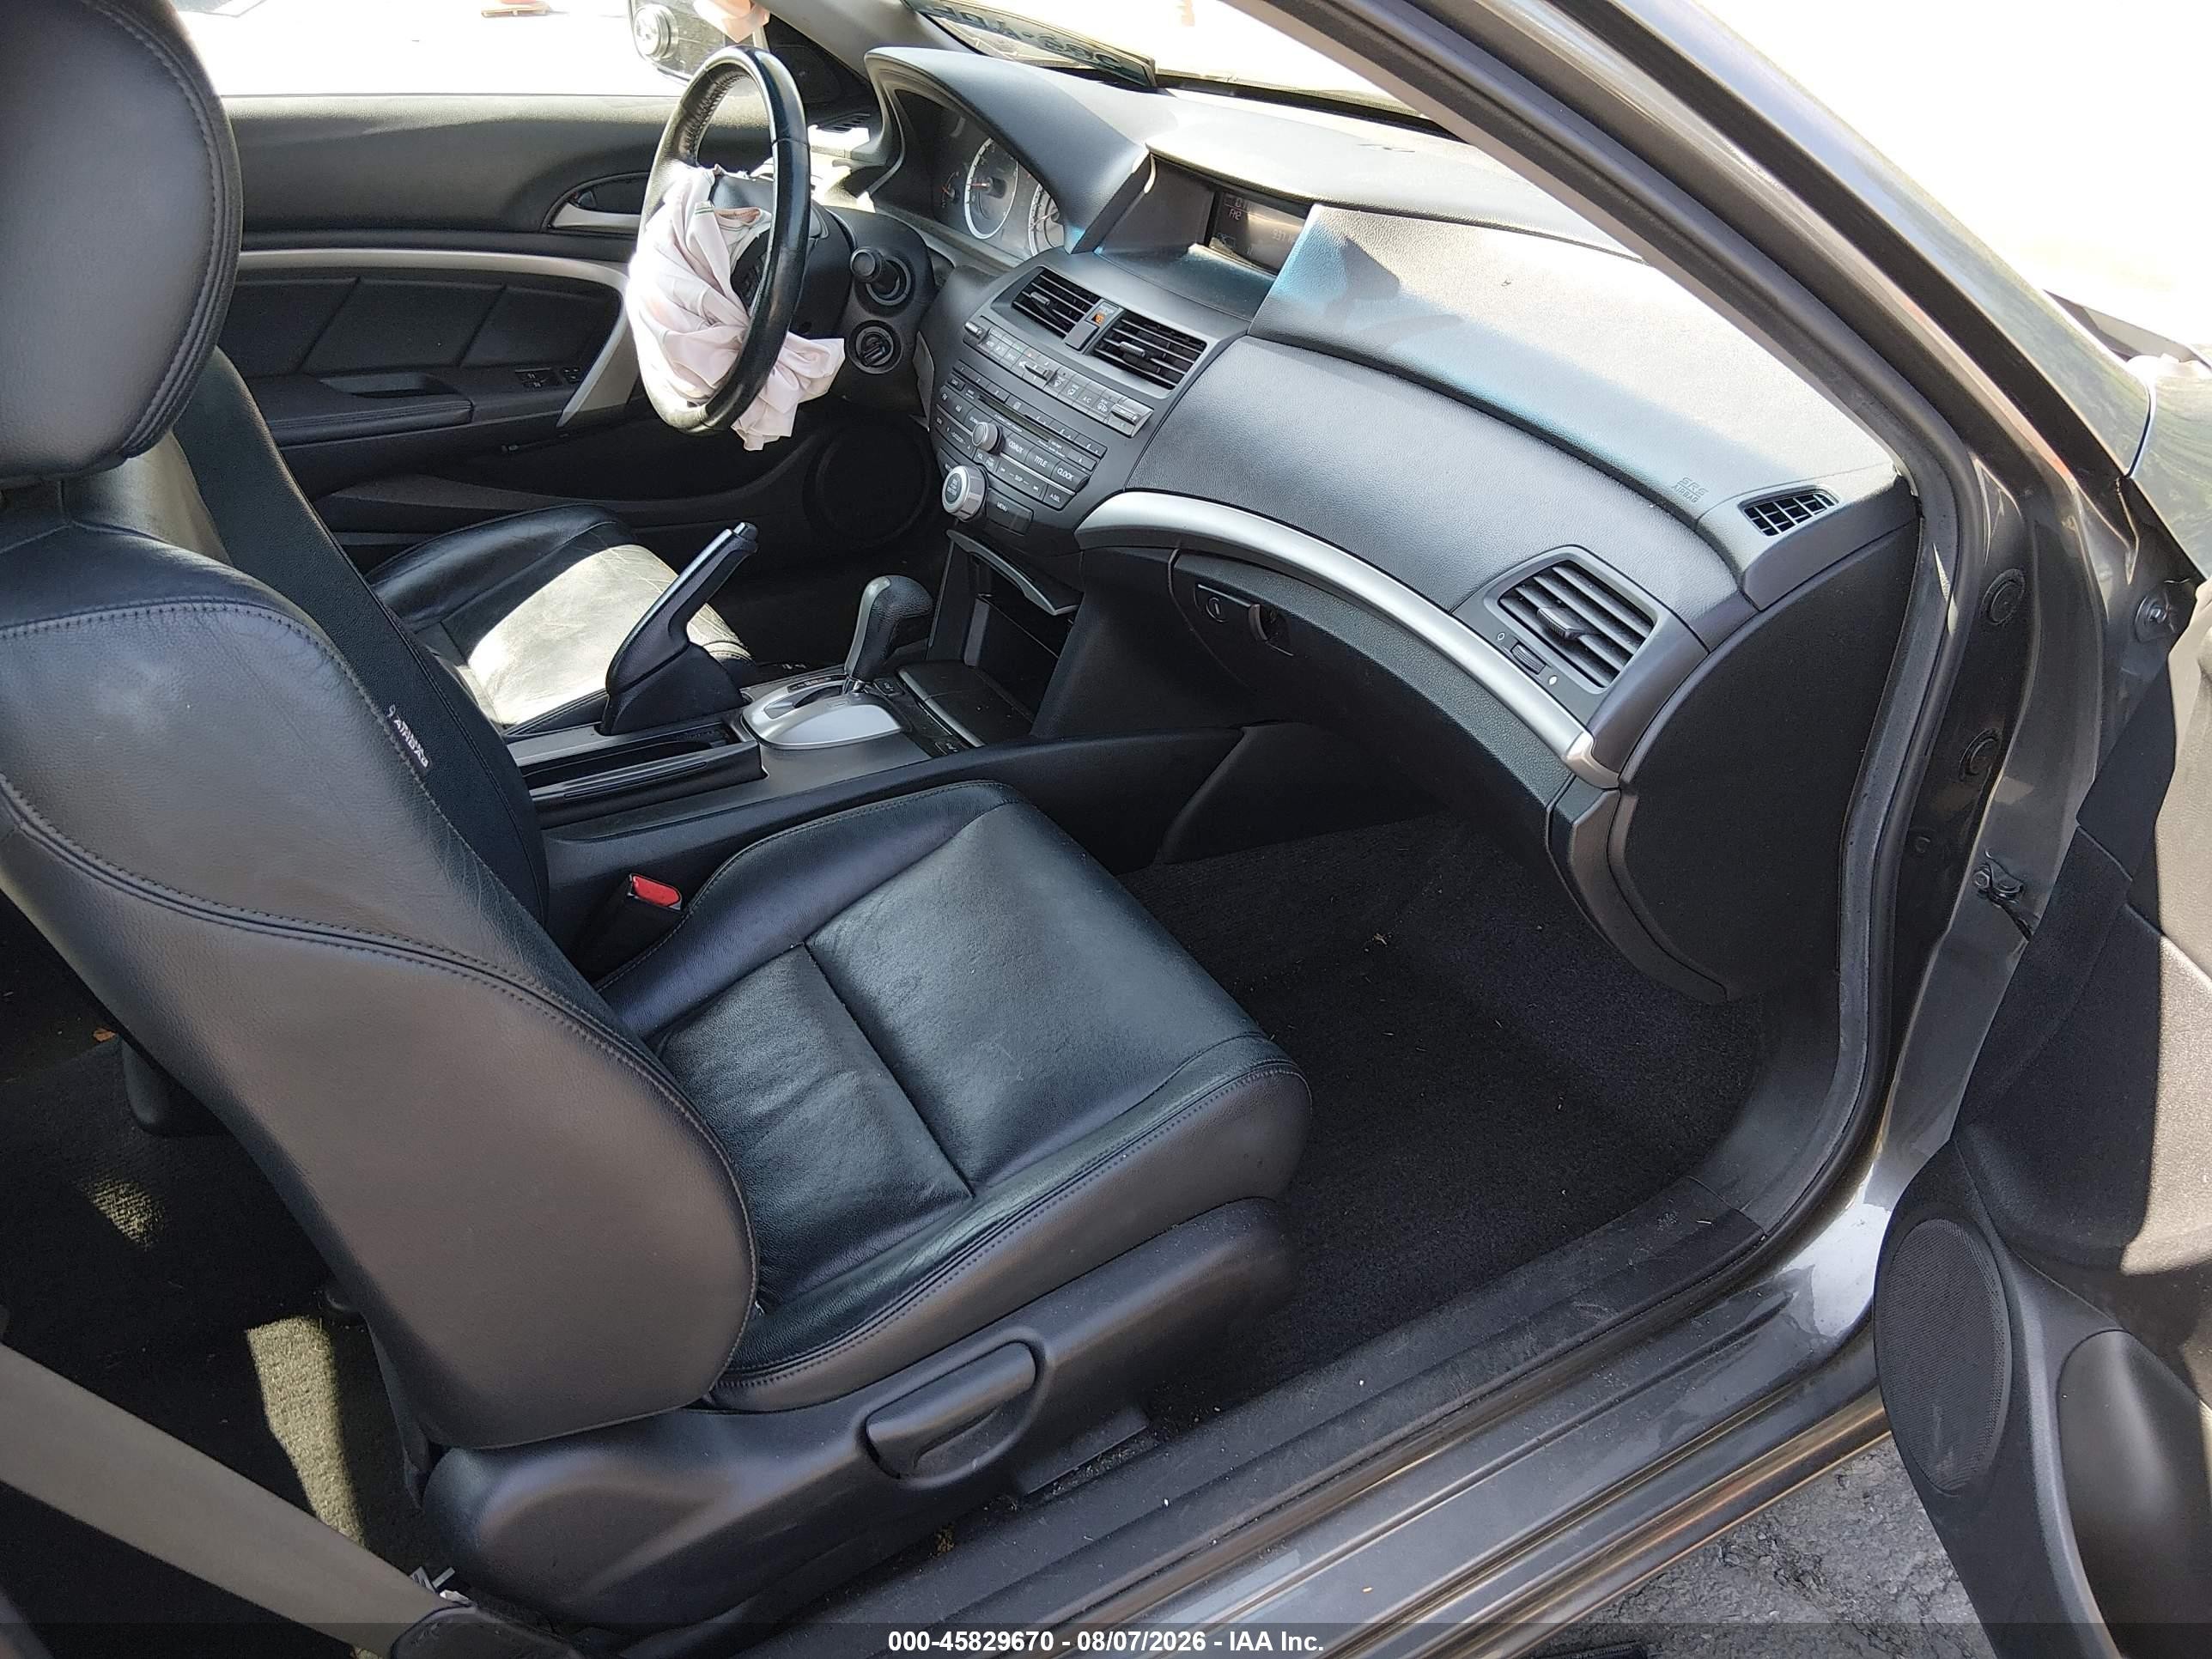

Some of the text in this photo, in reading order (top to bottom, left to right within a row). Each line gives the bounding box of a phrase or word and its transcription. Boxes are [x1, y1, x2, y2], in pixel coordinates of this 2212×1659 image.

[1034, 455, 1048, 468] TITLE
[1057, 467, 1074, 482] CLOCK
[1671, 484, 1699, 503] AIRBAG
[1679, 477, 1709, 496] SRS
